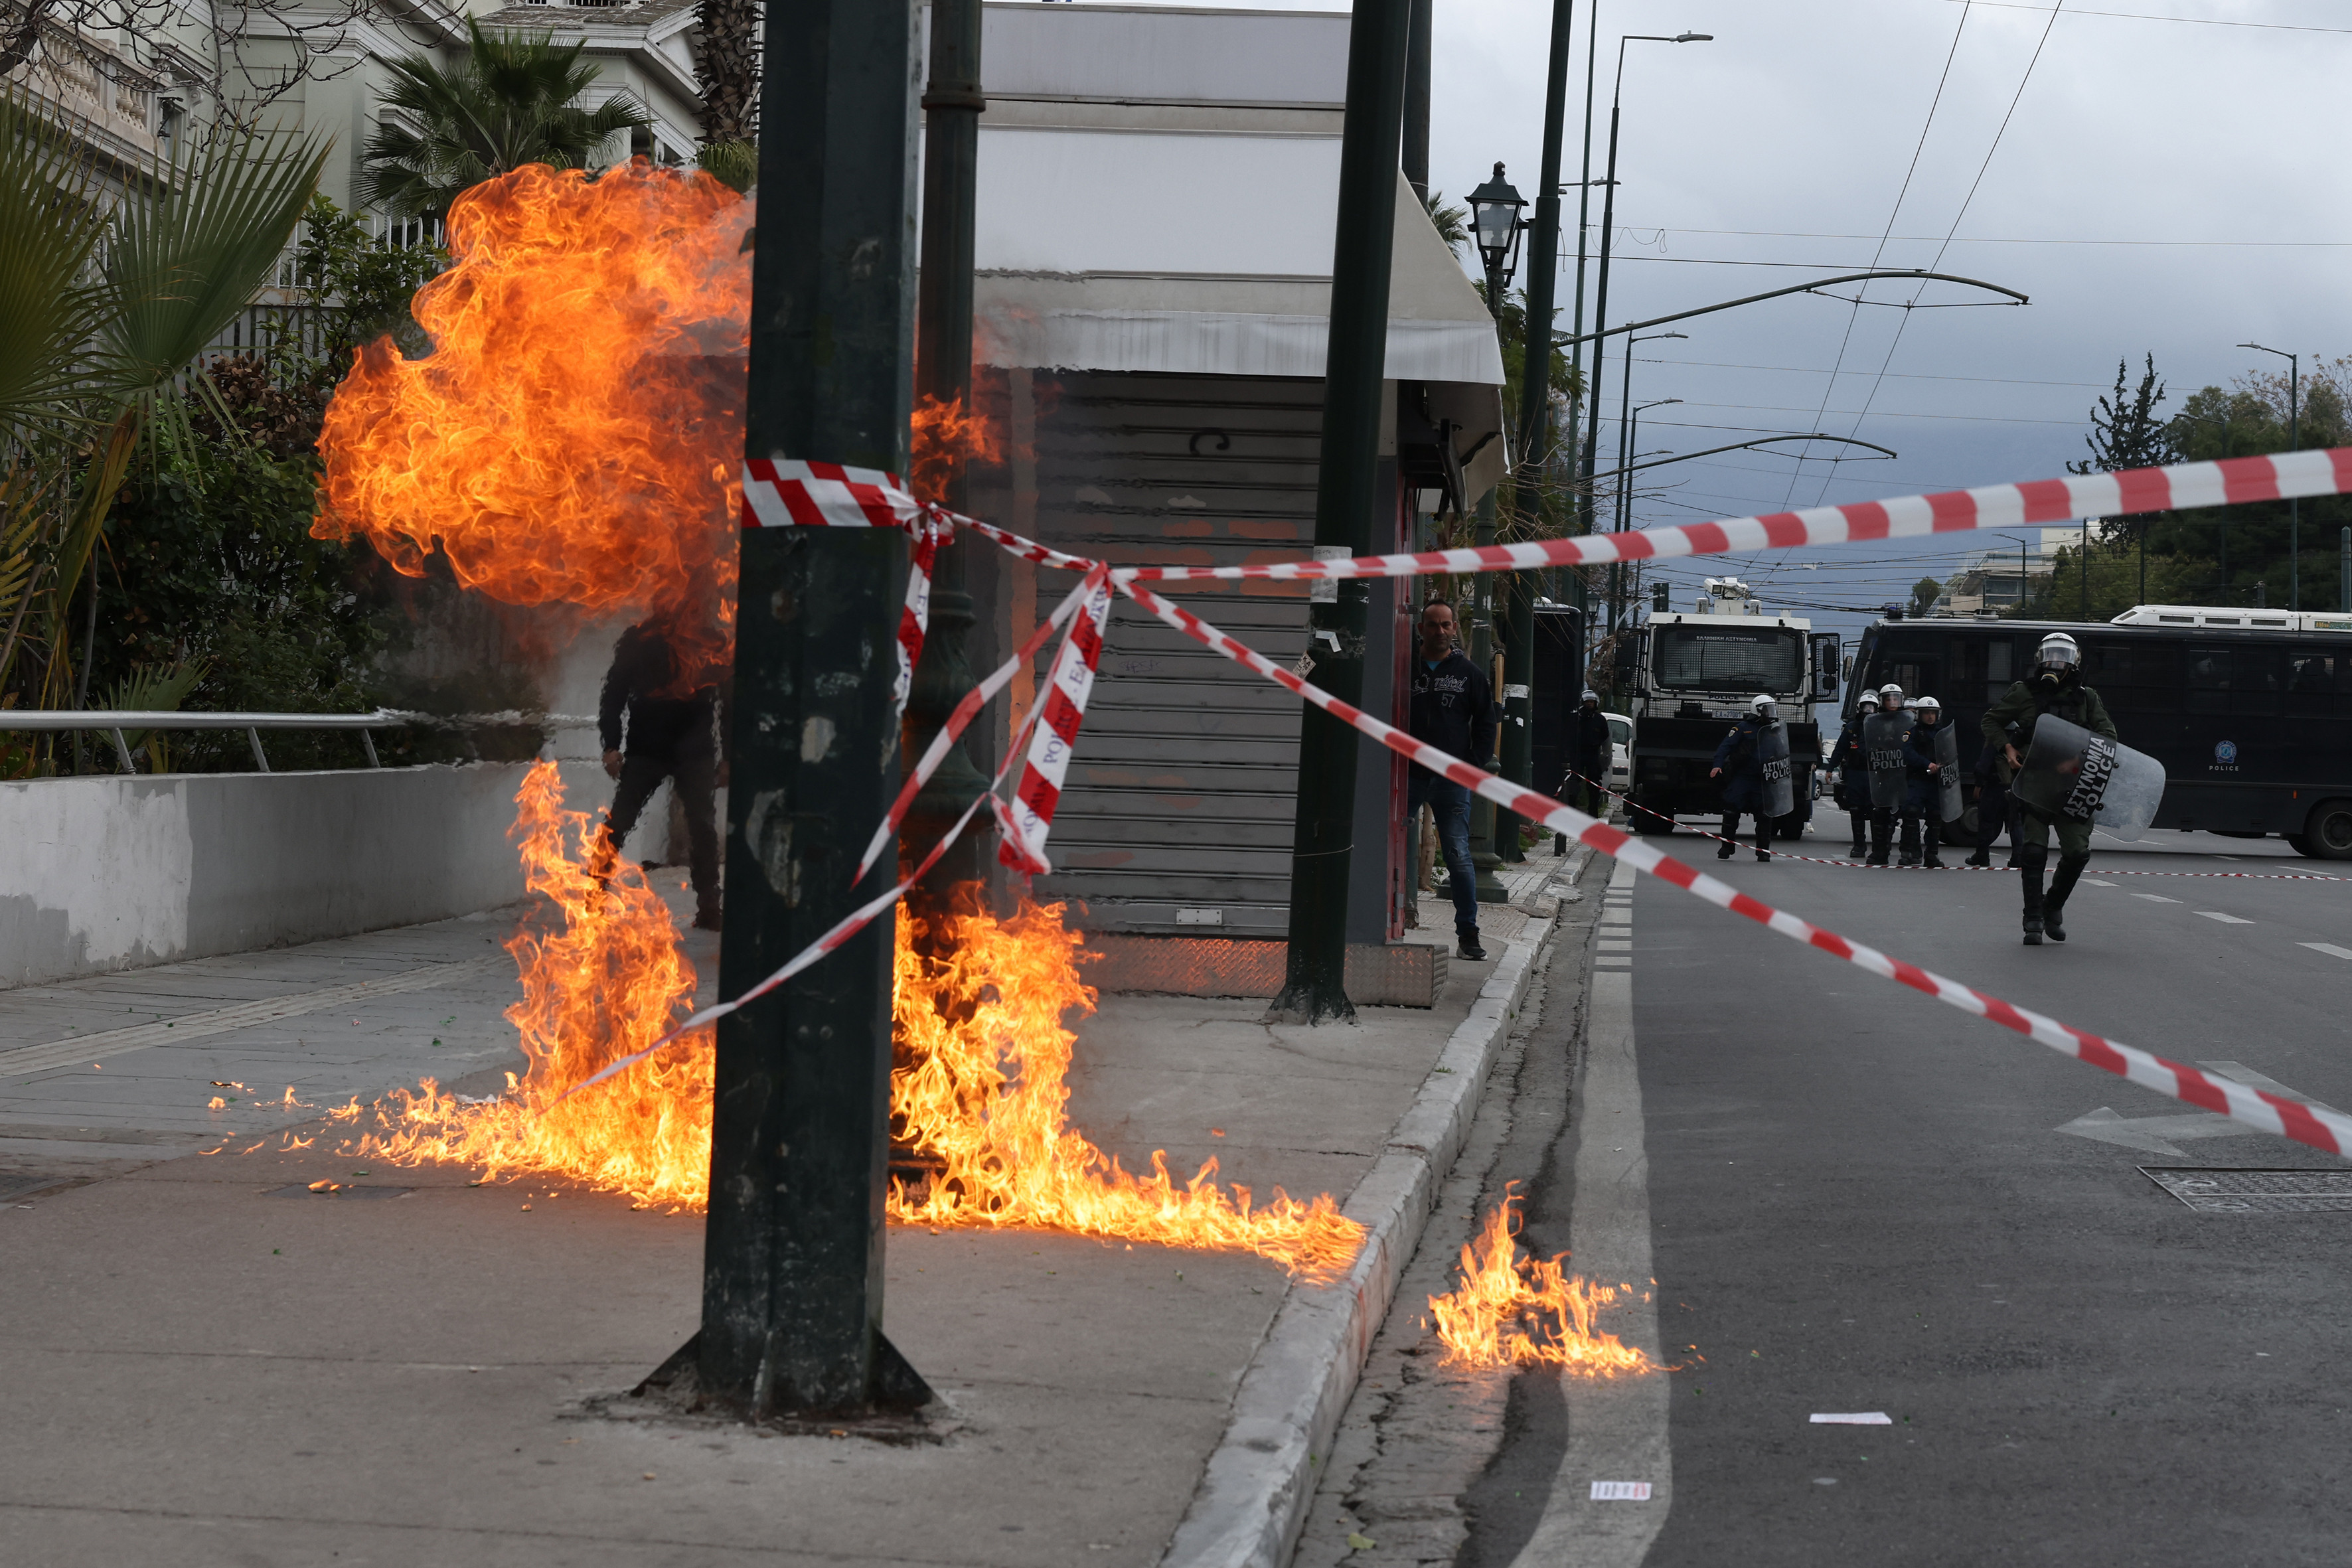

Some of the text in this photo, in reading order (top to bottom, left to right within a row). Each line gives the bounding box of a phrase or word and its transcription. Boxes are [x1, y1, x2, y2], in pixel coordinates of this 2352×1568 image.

[1441, 692, 1456, 708] 57
[1870, 749, 1903, 762] ΑΣΤΥΝΟ
[1873, 759, 1907, 770] POLIC
[2063, 737, 2105, 818] ΑΣΤΥΝΟΜΙΑ
[2077, 744, 2115, 819] POLICE
